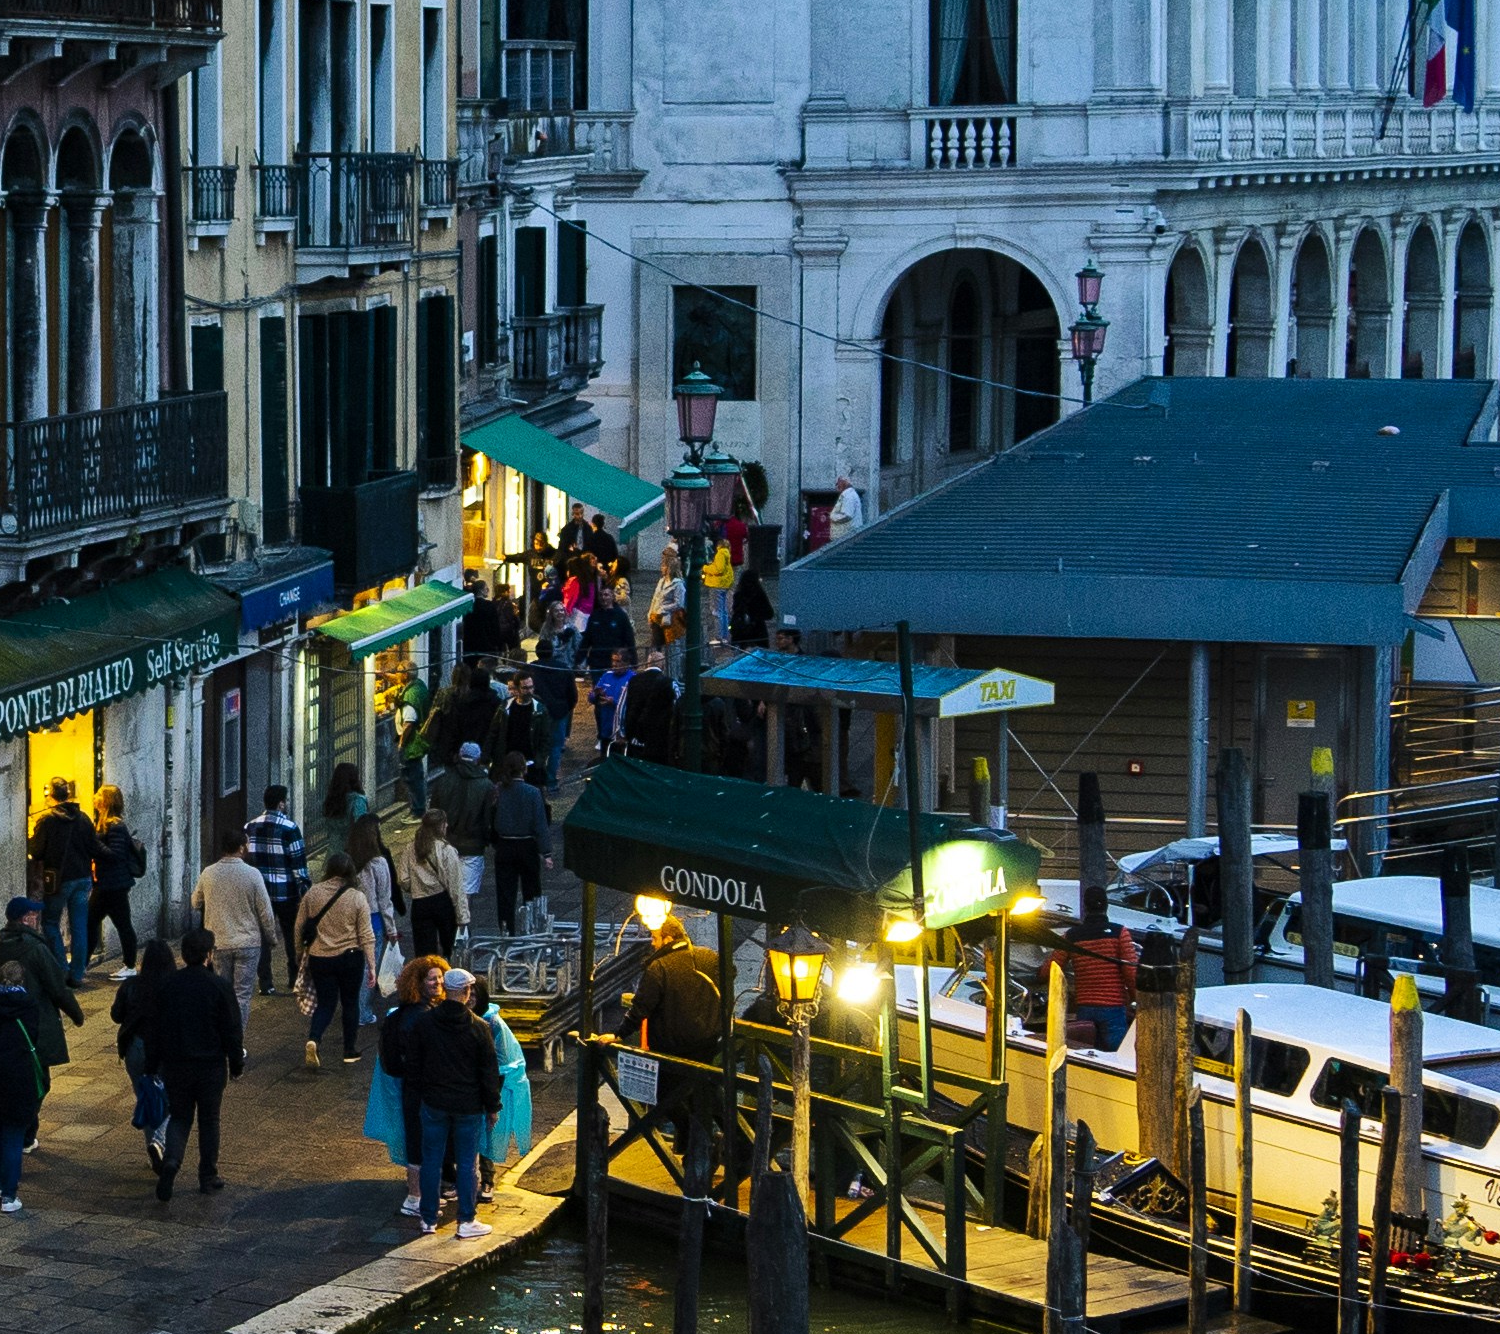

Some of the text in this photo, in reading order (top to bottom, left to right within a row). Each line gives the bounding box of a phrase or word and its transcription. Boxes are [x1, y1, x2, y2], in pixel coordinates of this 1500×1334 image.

[56, 677, 75, 717] DI
[77, 657, 134, 709] RIALTO
[146, 641, 172, 682] Self
[174, 628, 220, 670] Service
[660, 865, 767, 913] GONDOLA
[924, 866, 1007, 916] GOOLA
